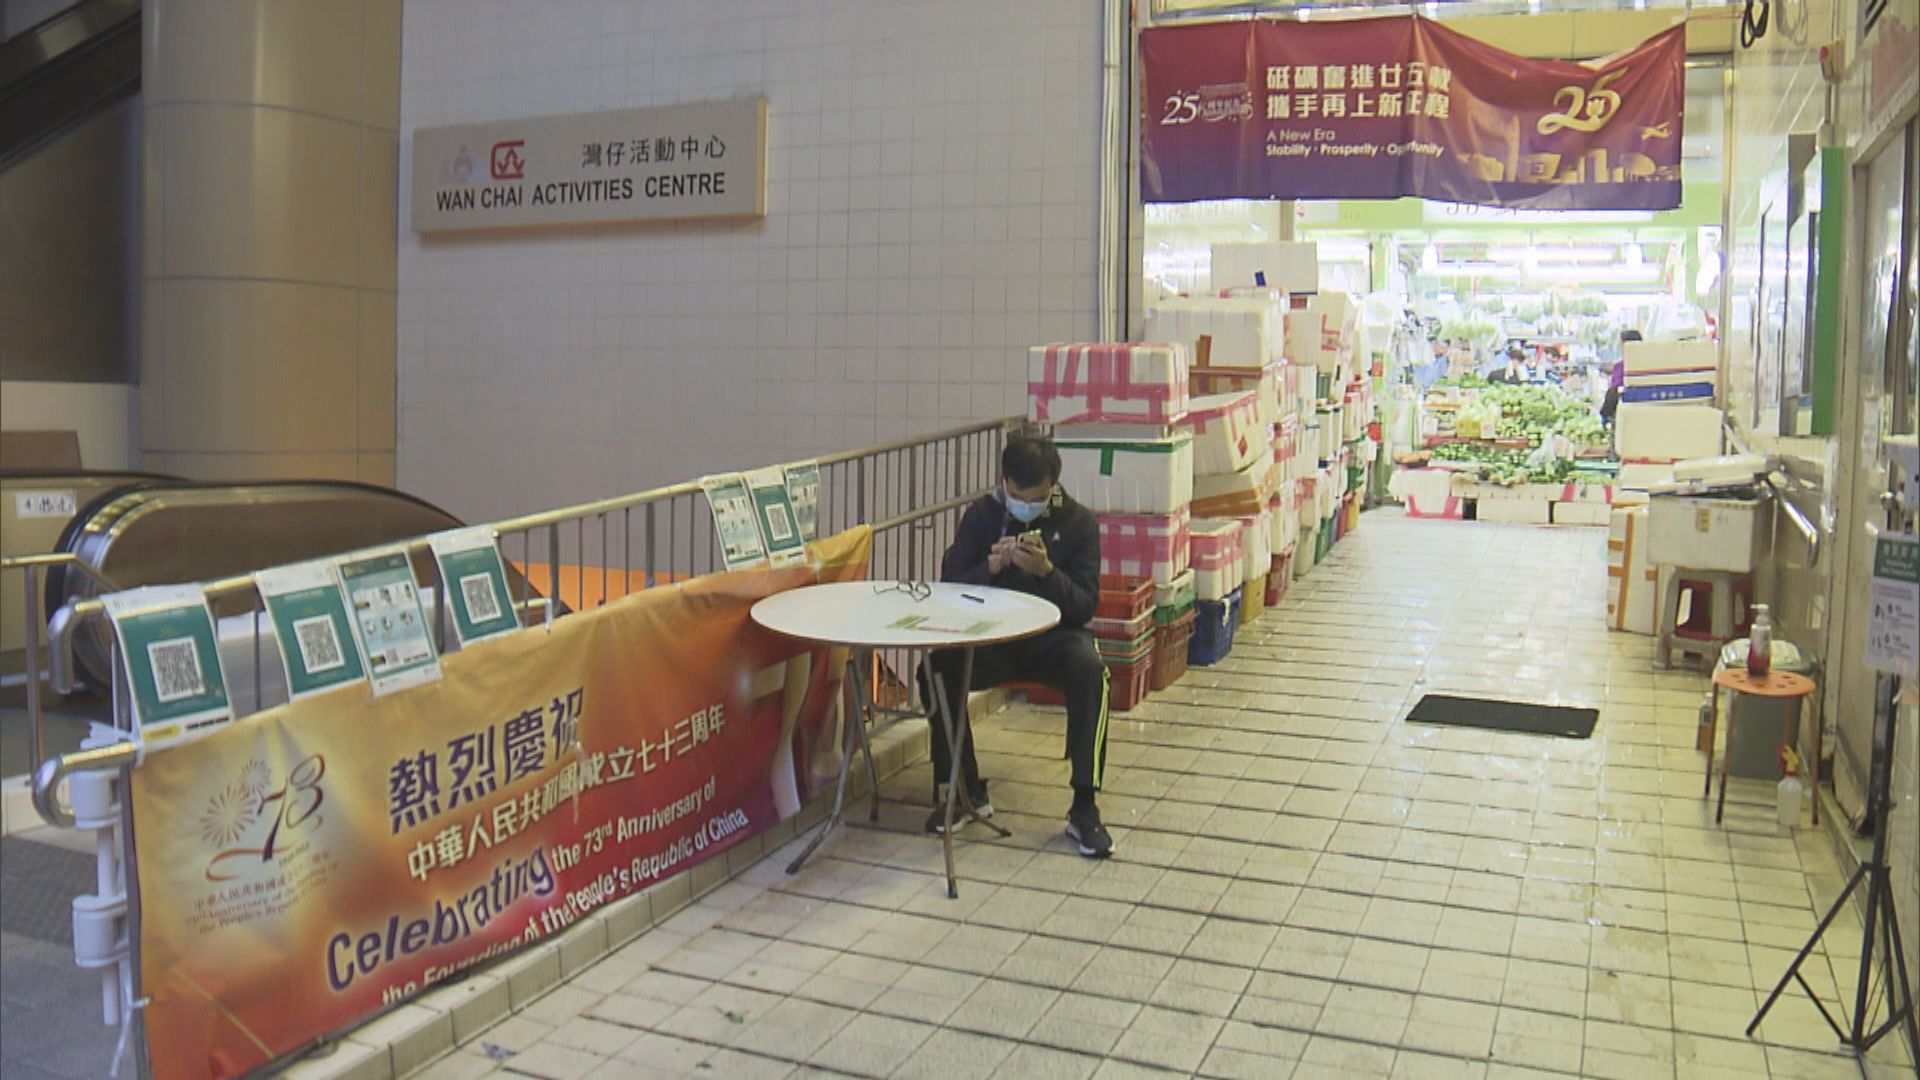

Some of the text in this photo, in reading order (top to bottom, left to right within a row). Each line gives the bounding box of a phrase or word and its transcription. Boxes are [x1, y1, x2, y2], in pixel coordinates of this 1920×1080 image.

[1160, 94, 1200, 125] 25
[1537, 66, 1629, 136] 25
[581, 134, 726, 167] 灣仔活動中心
[1266, 128, 1336, 141] A New Era
[1266, 143, 1311, 158] Stability
[1320, 142, 1378, 158] Prosperity
[436, 172, 725, 211] WAN CHAI ACTIVITIES CENTRE
[390, 687, 584, 835] 熱烈慶祝
[407, 703, 726, 882] 中華人民共和國成立七十三周年
[327, 845, 556, 991] Celebrating
[551, 841, 582, 874] the
[584, 818, 614, 857] 73rd
[617, 786, 702, 844] Anniversary
[704, 775, 717, 799] of
[381, 980, 417, 1007] the
[524, 915, 541, 942] of
[540, 906, 574, 935] the
[566, 866, 630, 916] People's
[631, 836, 694, 884] Republic
[695, 826, 708, 851] of
[708, 808, 749, 842] China
